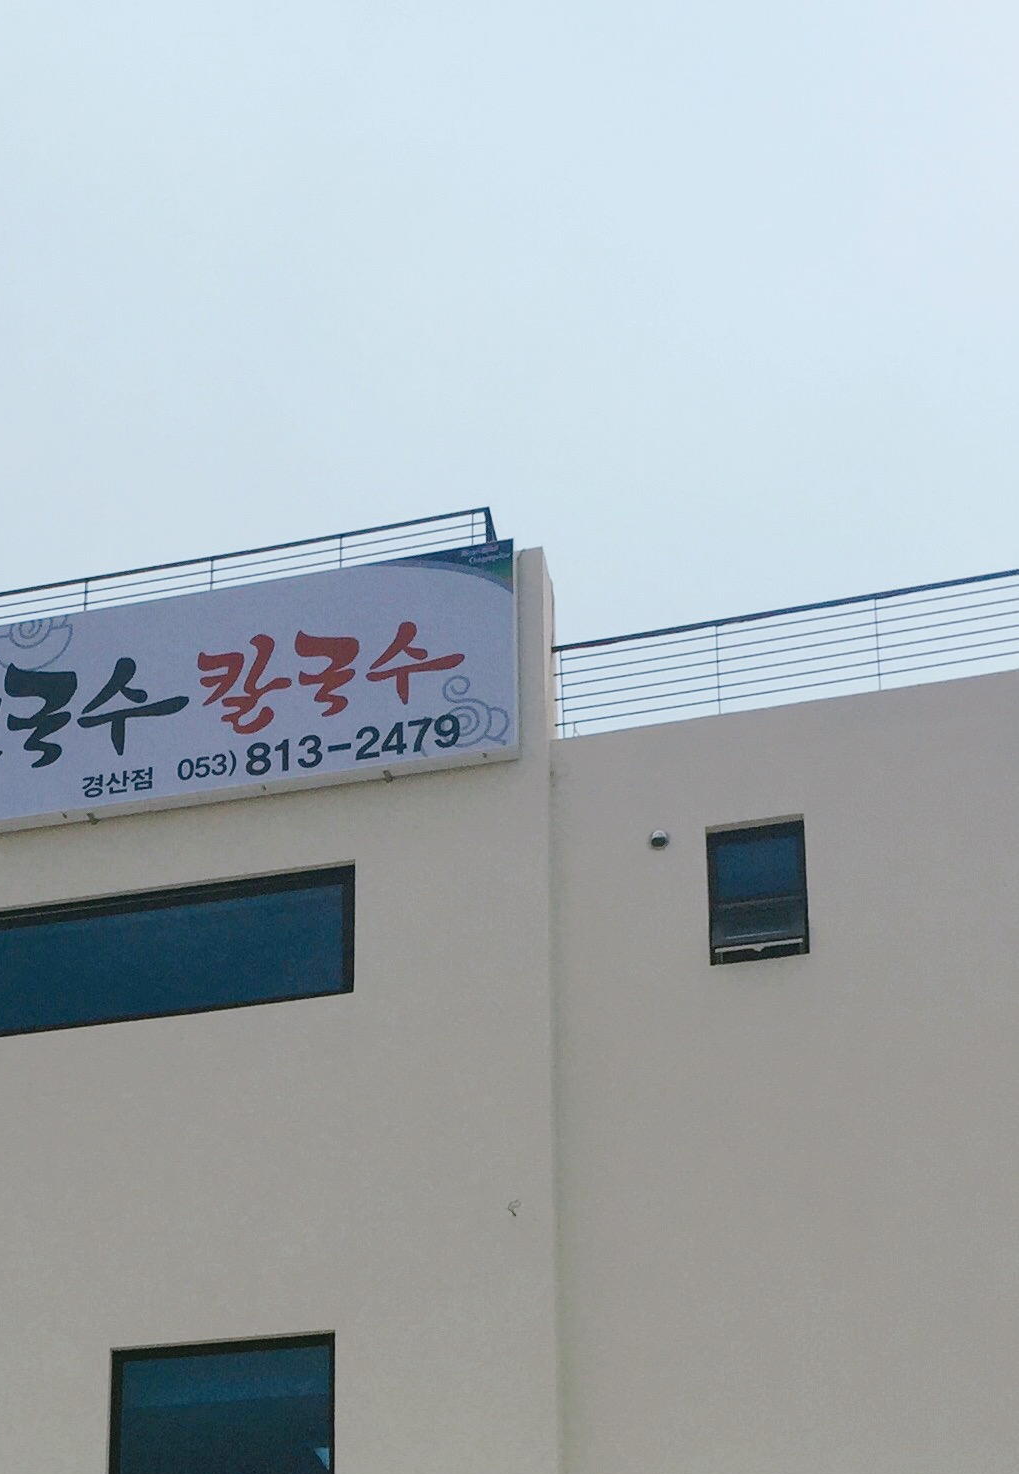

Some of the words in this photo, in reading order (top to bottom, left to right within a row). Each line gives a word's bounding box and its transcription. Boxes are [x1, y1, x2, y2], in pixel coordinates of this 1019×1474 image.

[197, 621, 465, 734] 칼국수
[82, 767, 154, 798] 경산점
[246, 714, 460, 776] 813-2479
